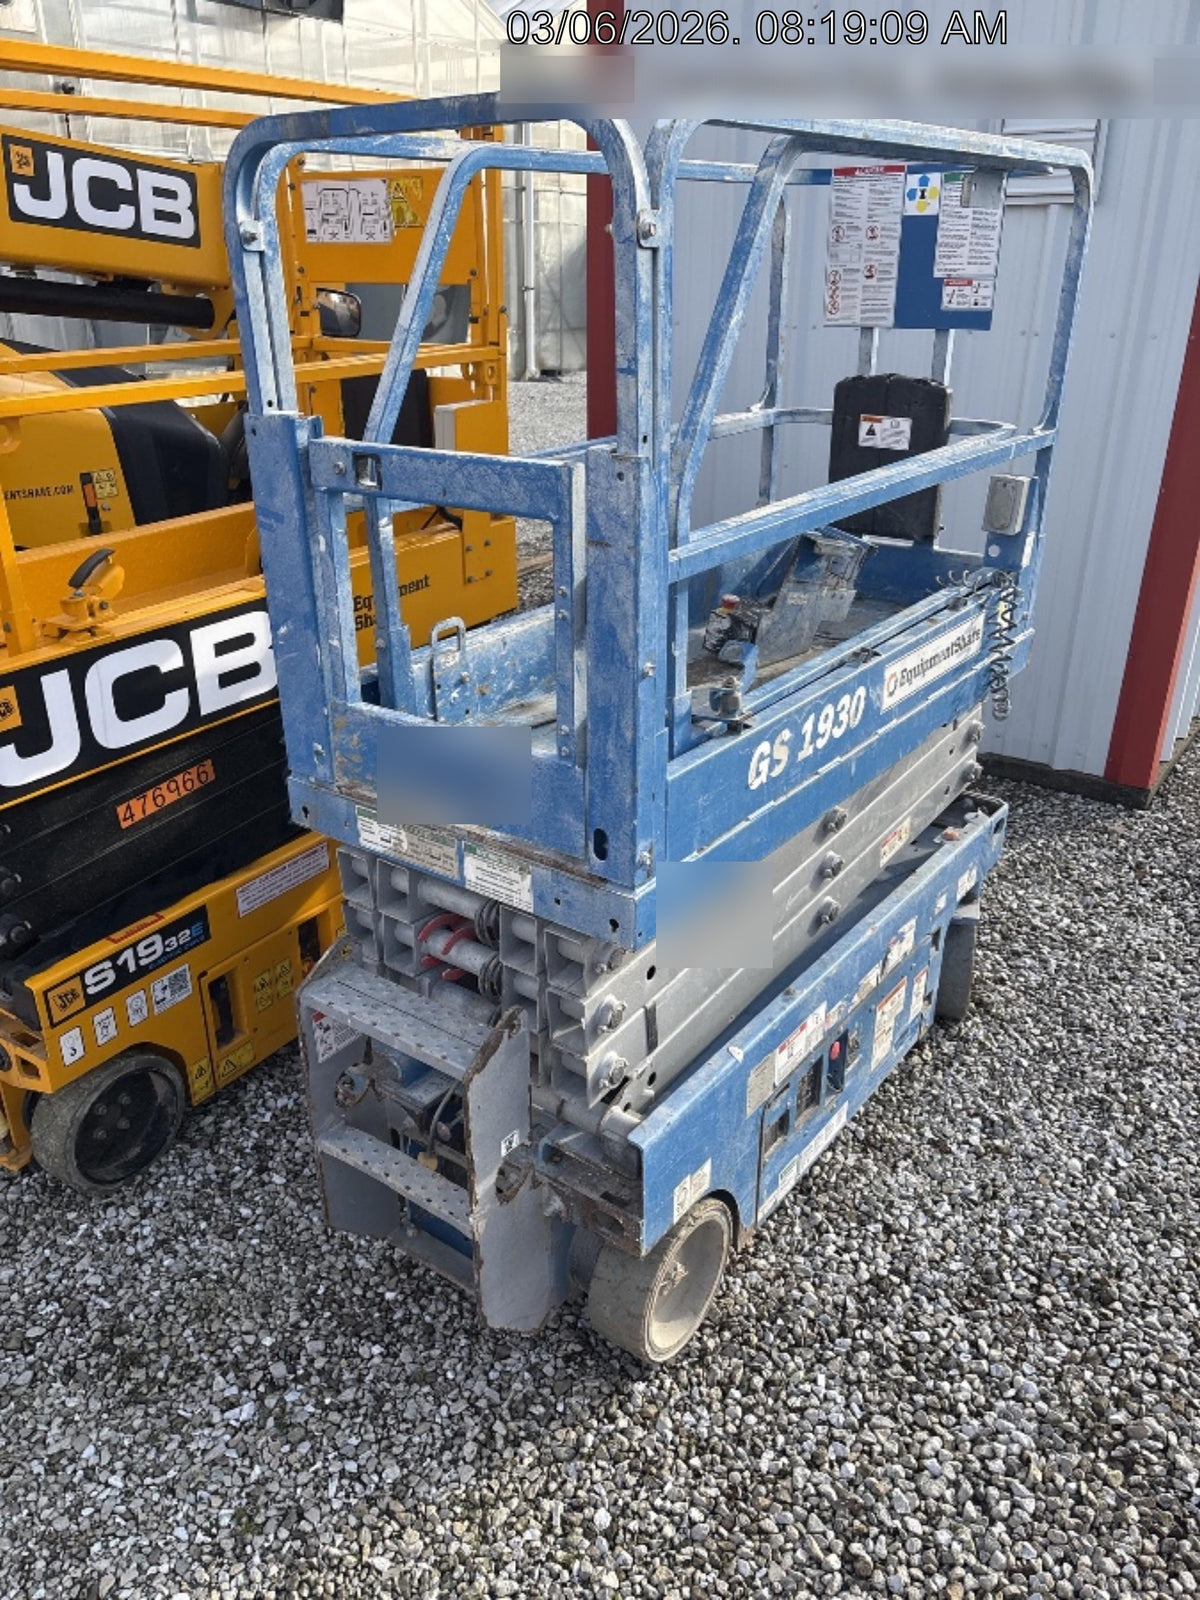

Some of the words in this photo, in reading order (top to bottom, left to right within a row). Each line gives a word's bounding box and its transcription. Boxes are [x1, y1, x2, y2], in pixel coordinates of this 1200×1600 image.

[14, 150, 195, 239] JCB
[0, 611, 279, 787] JCB
[748, 728, 793, 791] GS
[797, 685, 867, 763] 1930
[122, 760, 213, 824] 476966
